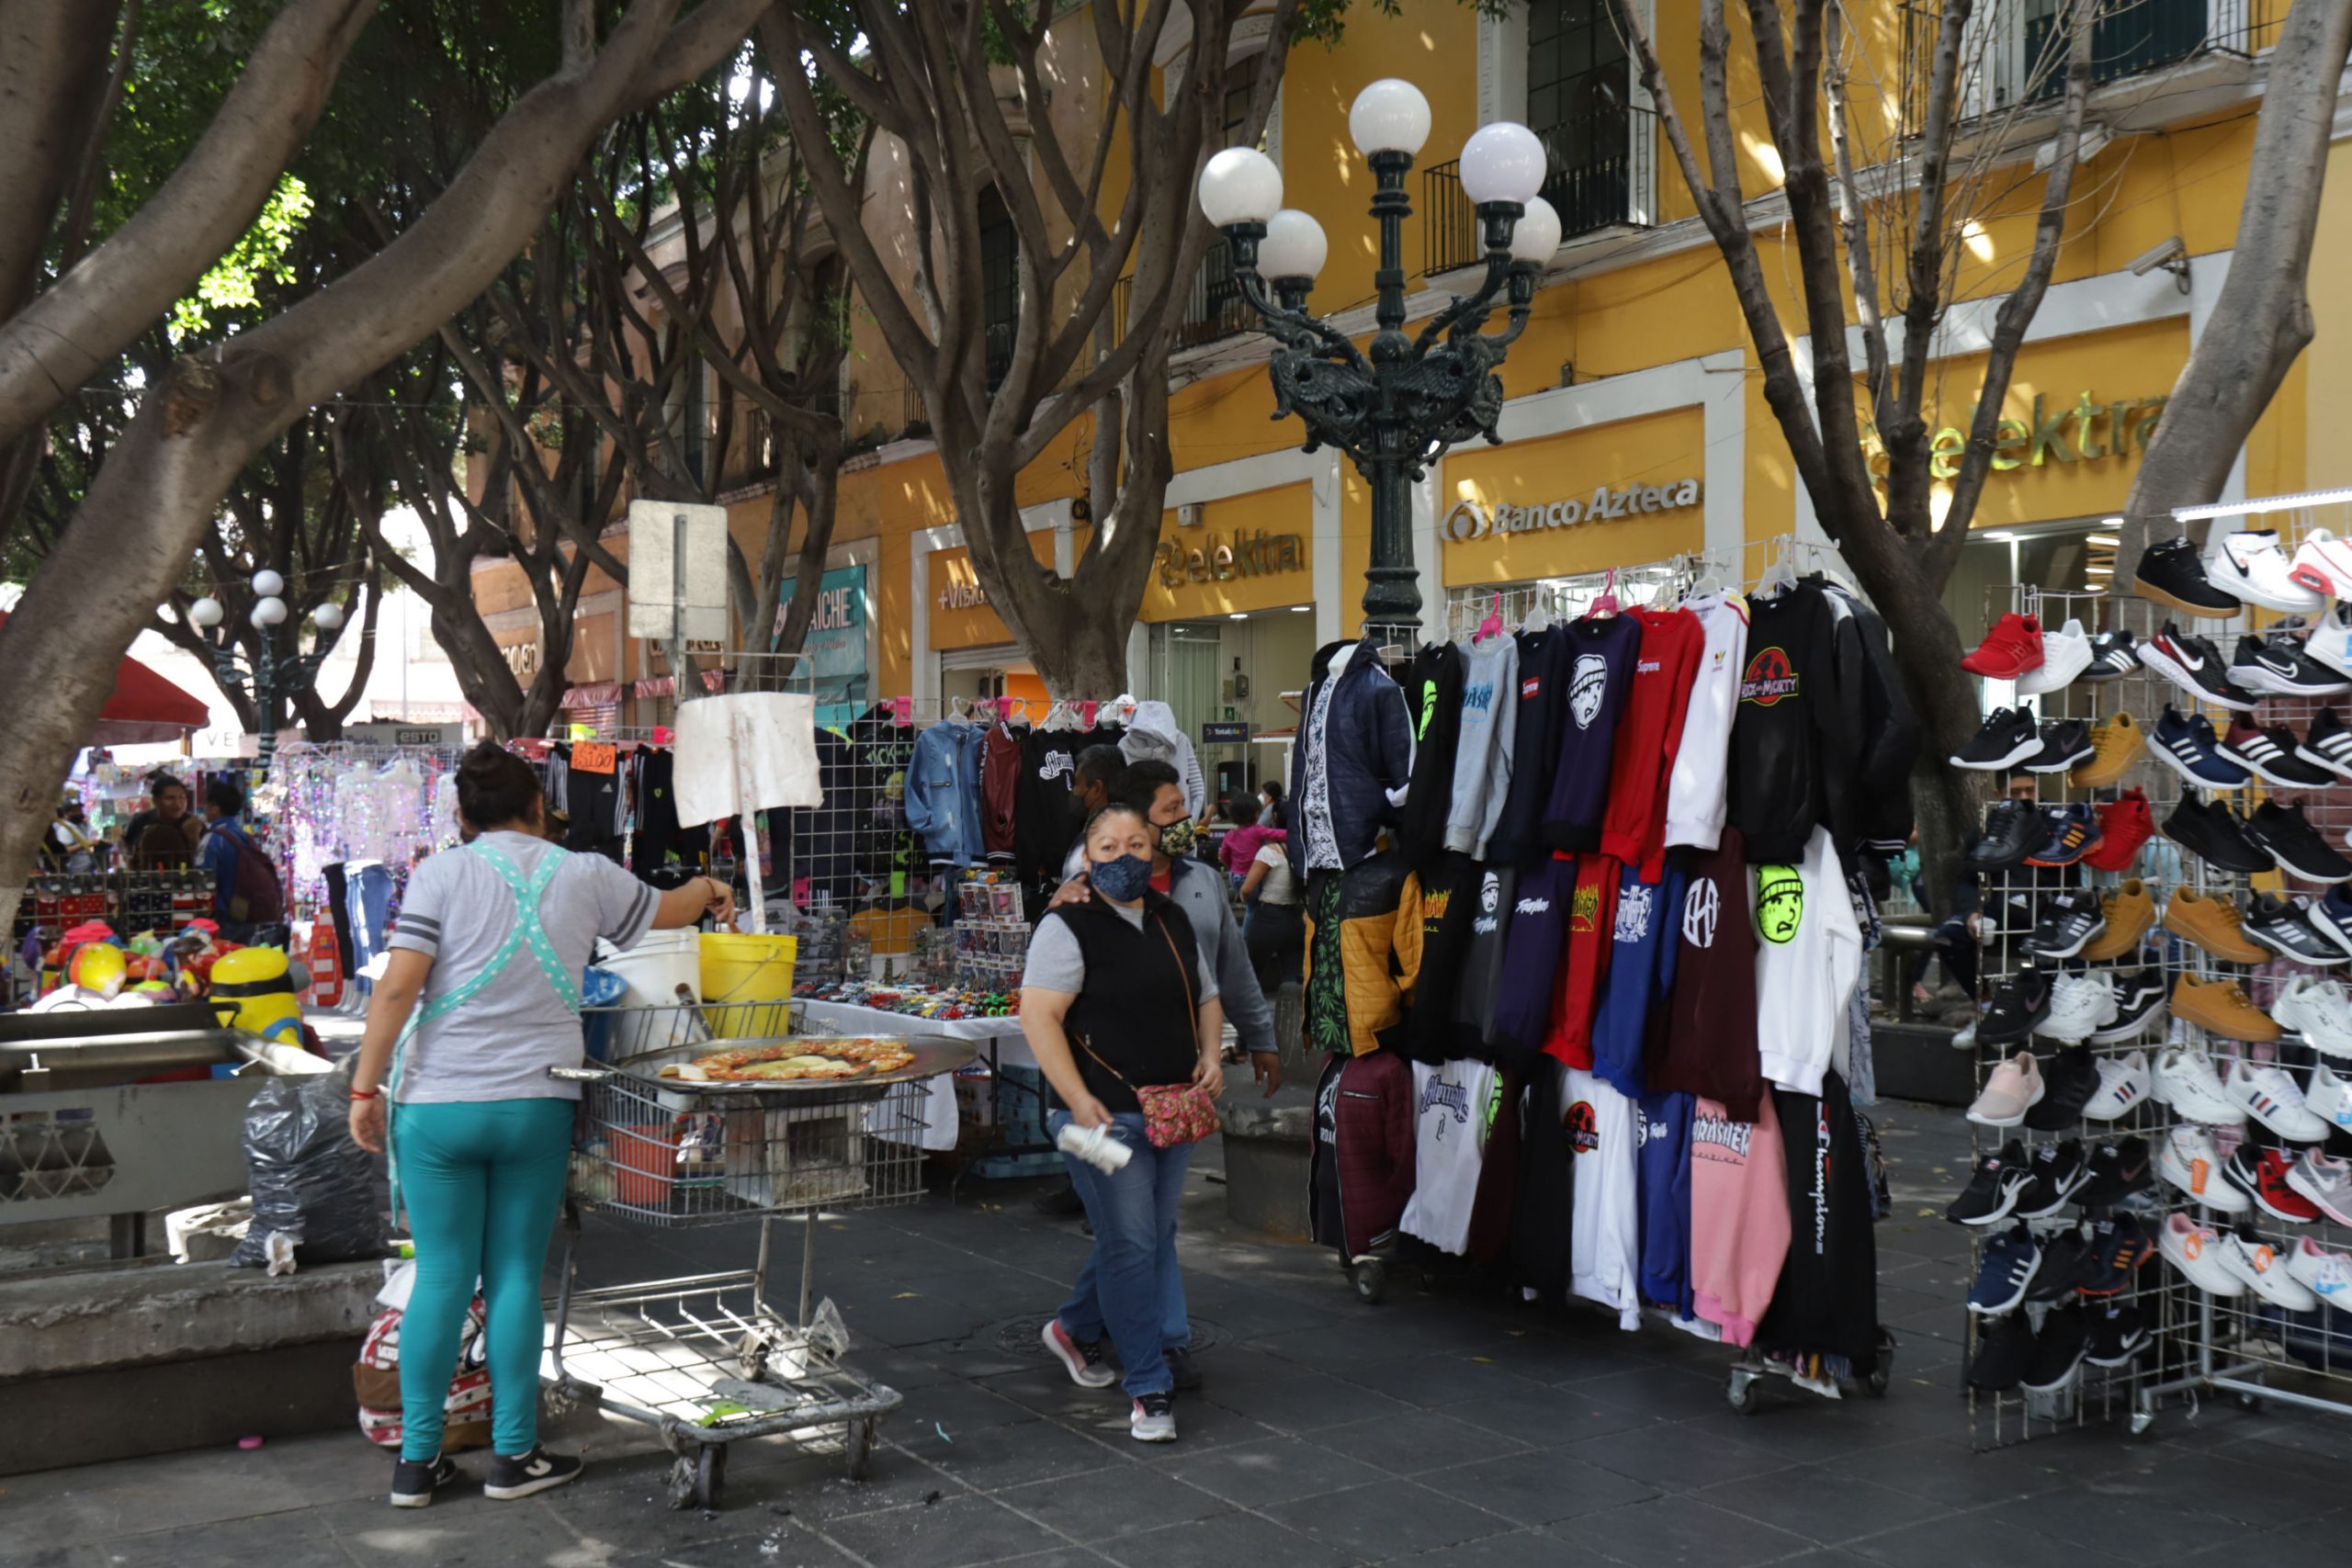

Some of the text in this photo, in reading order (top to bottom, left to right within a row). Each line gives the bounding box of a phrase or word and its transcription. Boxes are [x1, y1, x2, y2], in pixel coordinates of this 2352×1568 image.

[1491, 478, 1699, 536] Banco Azteca
[1186, 528, 1302, 583] elektra
[1807, 1119, 1831, 1243] Champion
